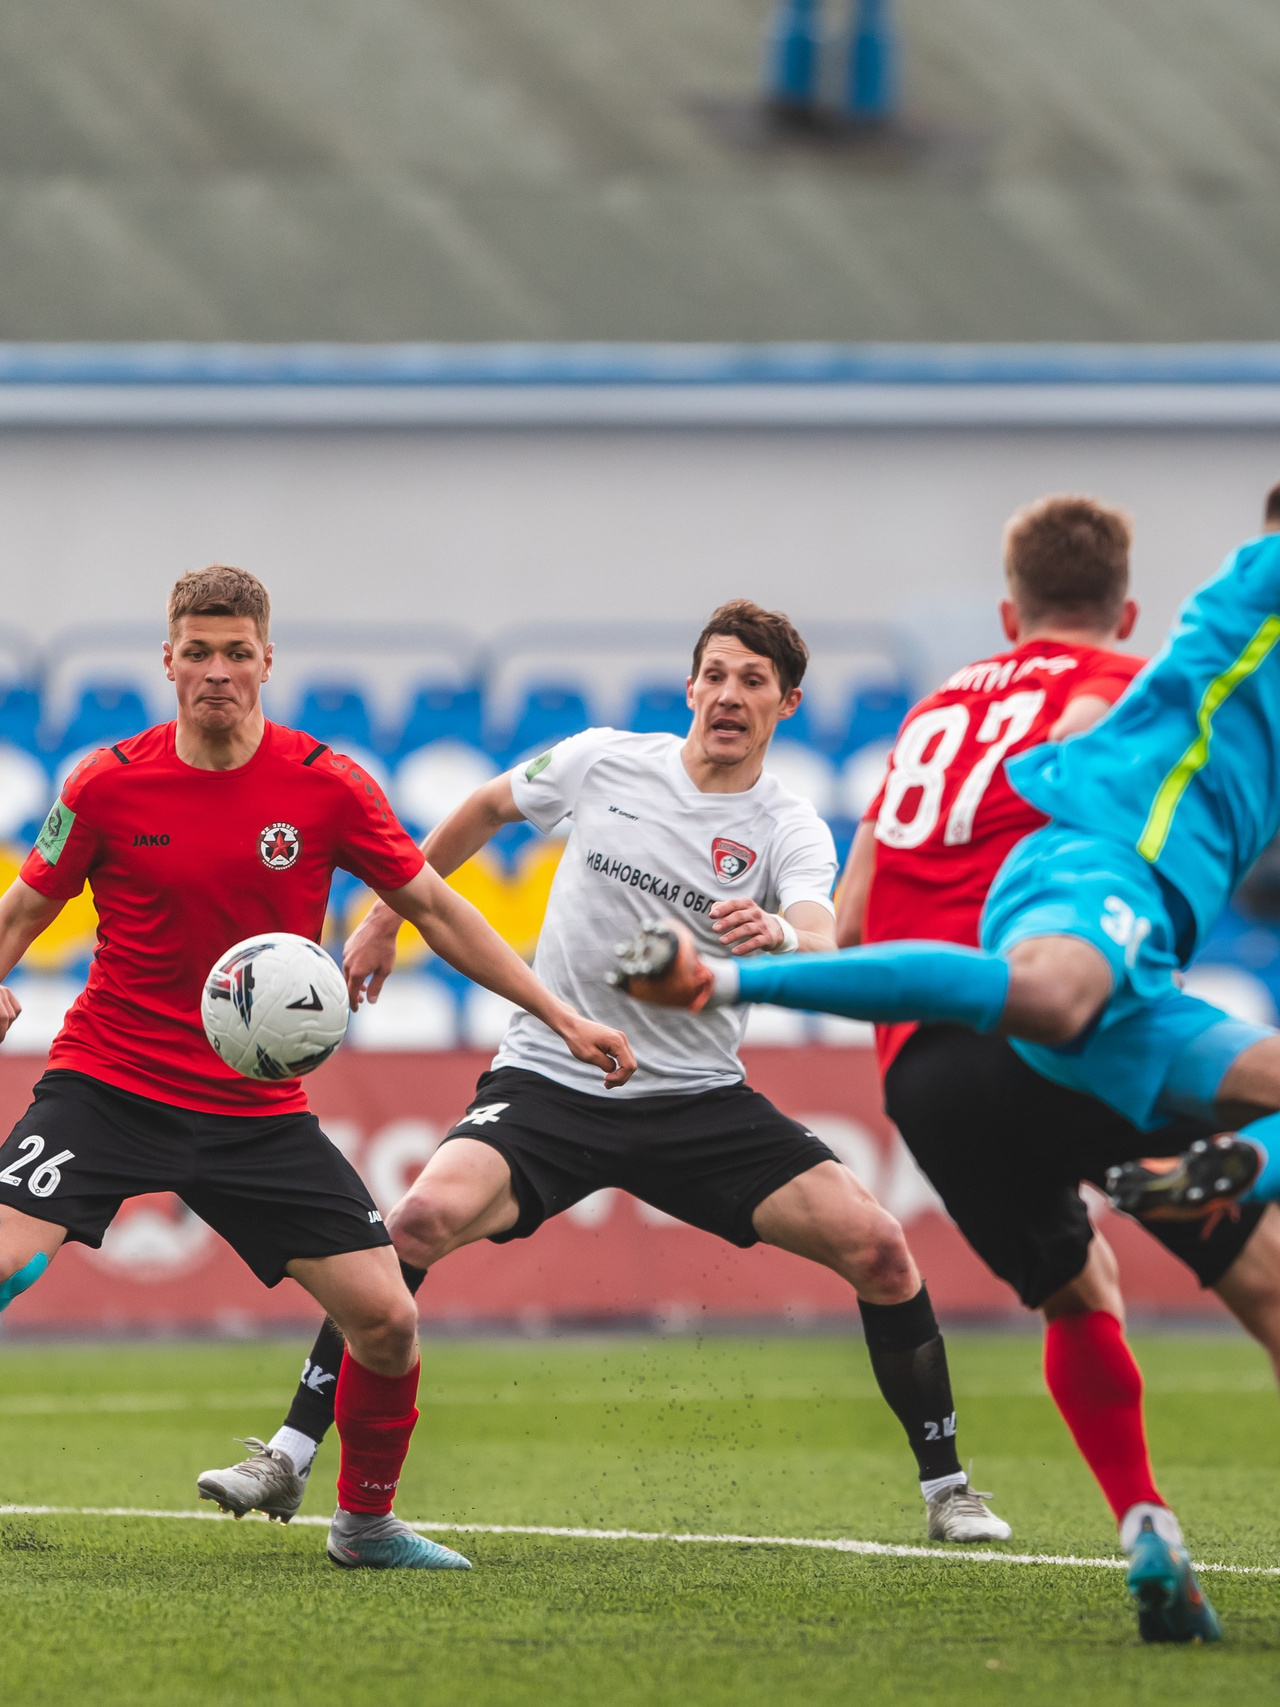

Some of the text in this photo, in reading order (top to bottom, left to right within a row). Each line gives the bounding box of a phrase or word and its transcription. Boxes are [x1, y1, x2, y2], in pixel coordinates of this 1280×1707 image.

[874, 689, 1047, 849] 87
[132, 834, 171, 847] JAKO
[585, 848, 682, 903] ИВАНОВСКАЯ
[0, 1134, 76, 1198] 26
